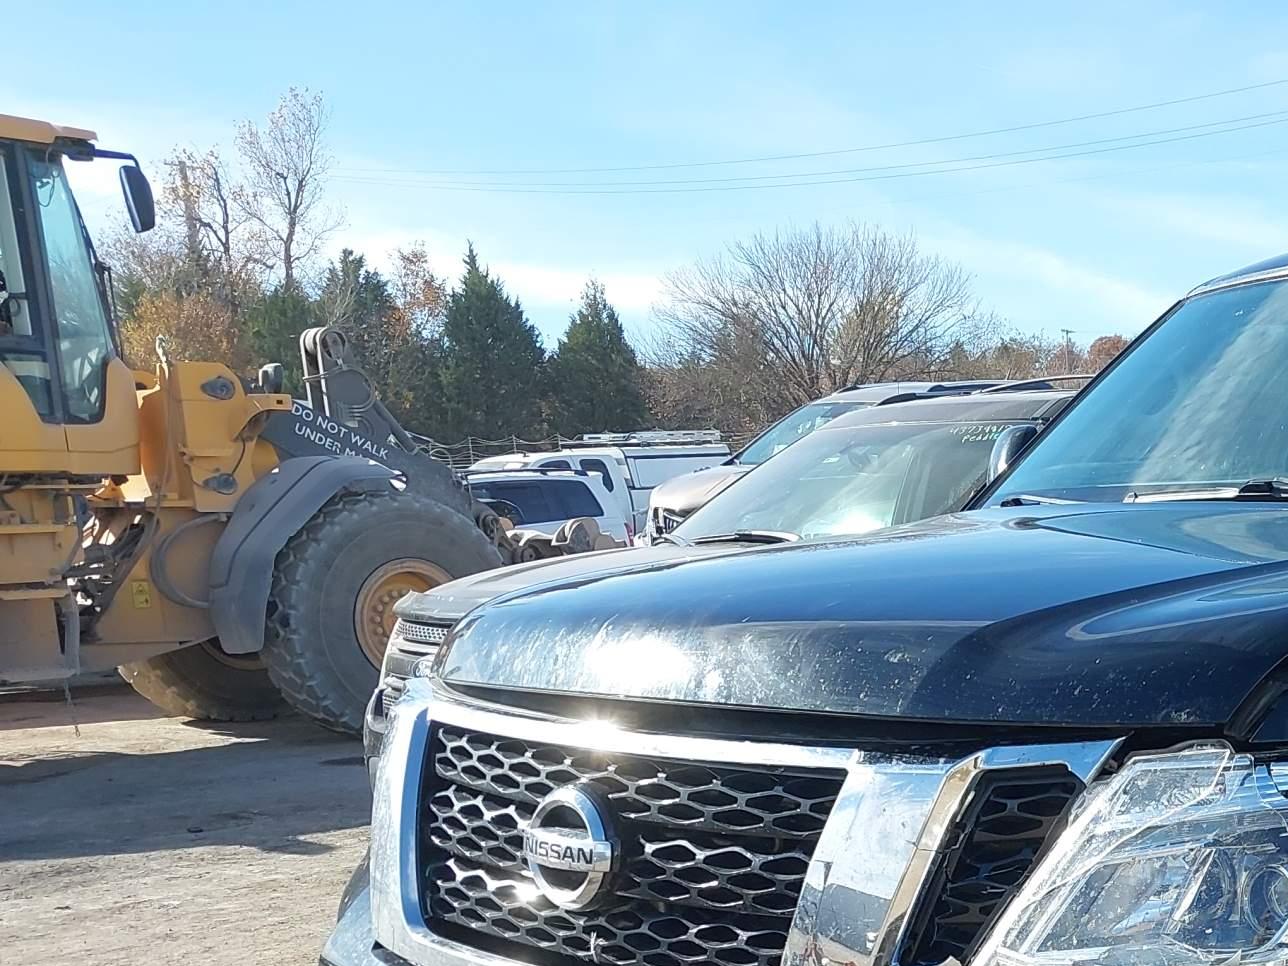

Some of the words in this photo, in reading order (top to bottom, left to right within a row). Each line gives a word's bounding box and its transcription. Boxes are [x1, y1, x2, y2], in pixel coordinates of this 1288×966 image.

[291, 403, 314, 421] DO
[316, 416, 349, 438] NOT
[351, 432, 389, 460] WALK
[294, 422, 342, 454] UNDER
[524, 836, 595, 865] NISSAN
